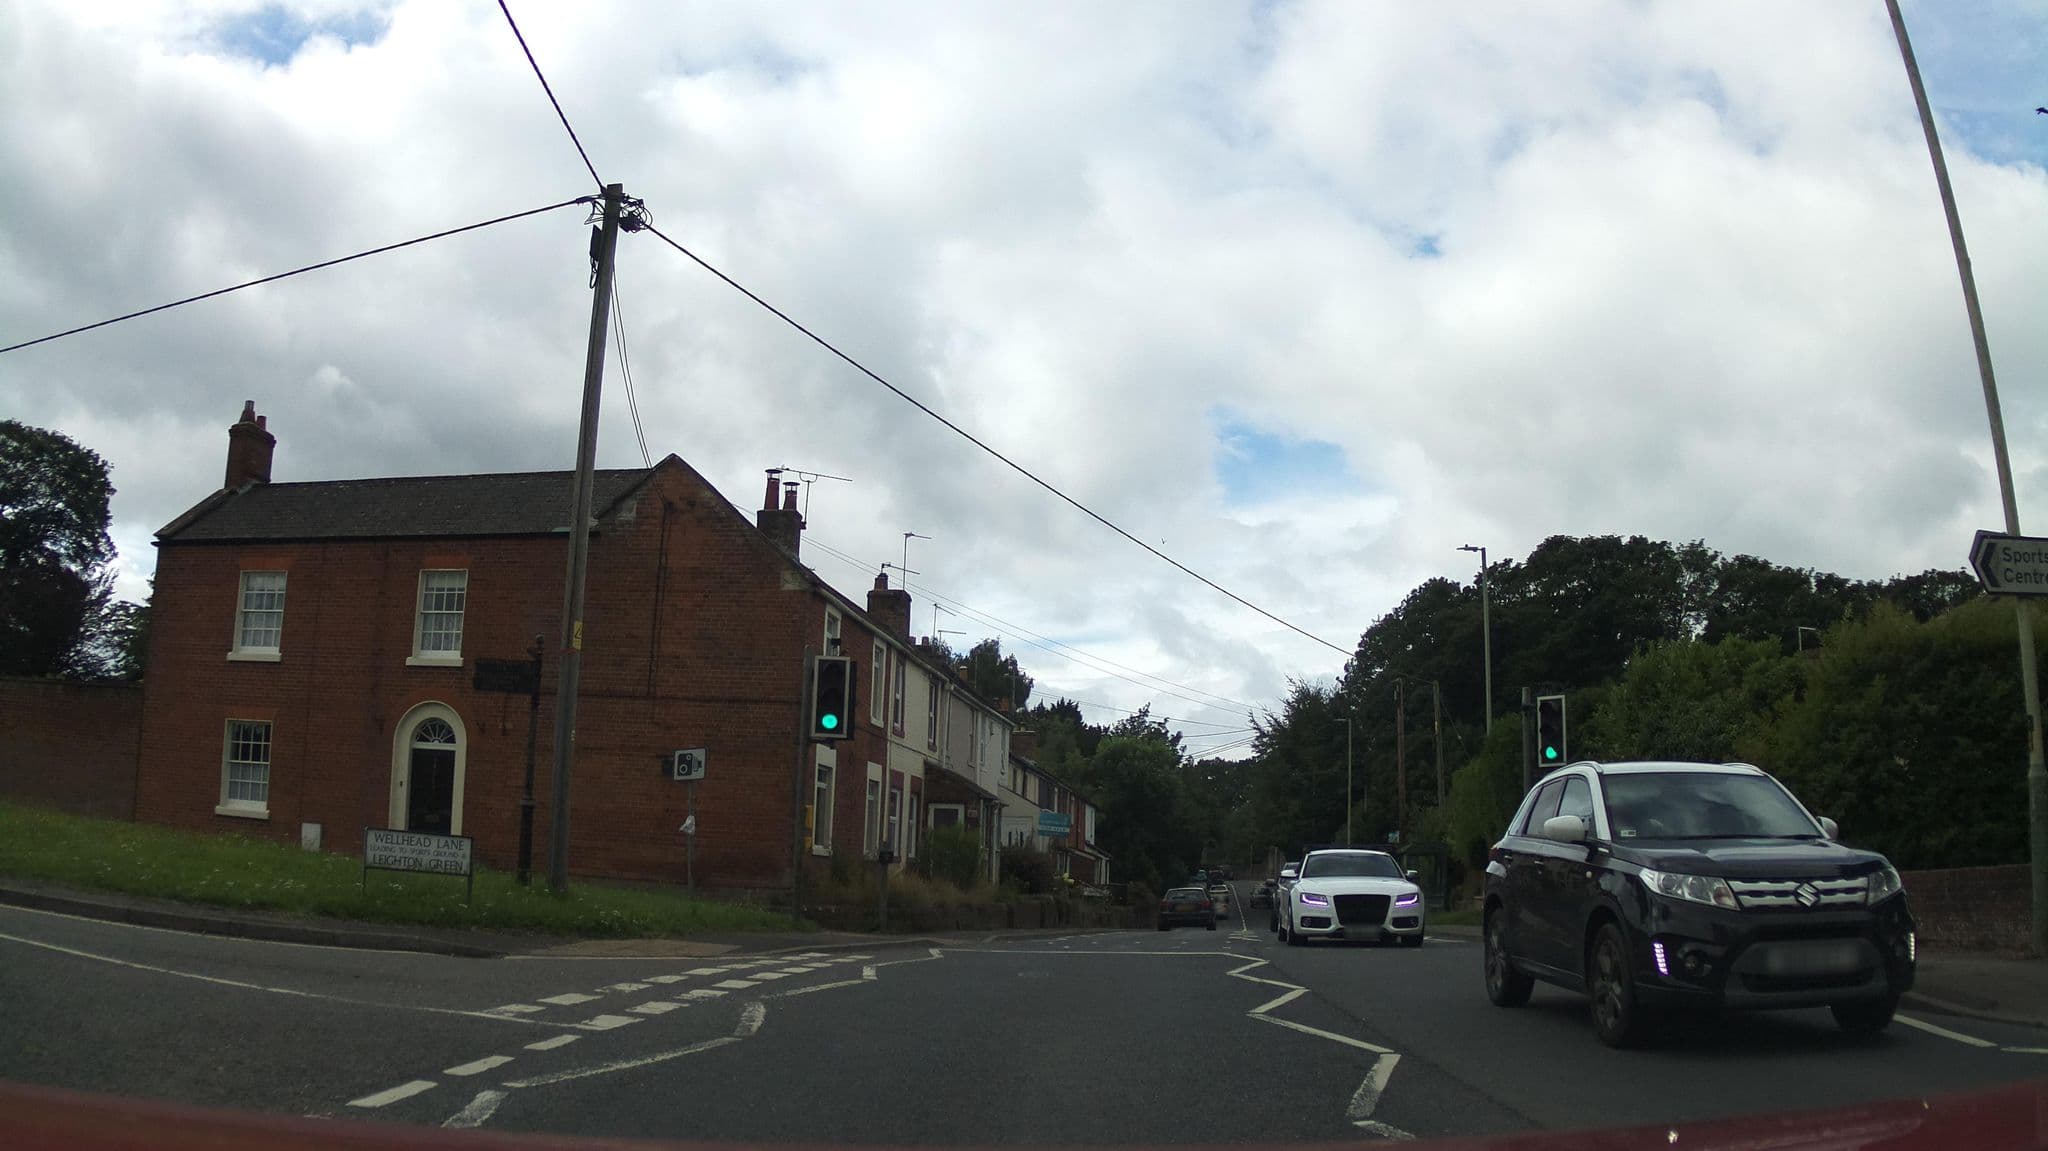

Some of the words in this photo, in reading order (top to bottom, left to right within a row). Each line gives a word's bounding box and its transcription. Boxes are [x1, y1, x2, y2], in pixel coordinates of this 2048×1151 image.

[374, 831, 432, 848] WELLHEAD
[437, 838, 465, 851] LANE
[372, 853, 423, 868] LEIGHTON
[429, 858, 464, 871] GREEN
